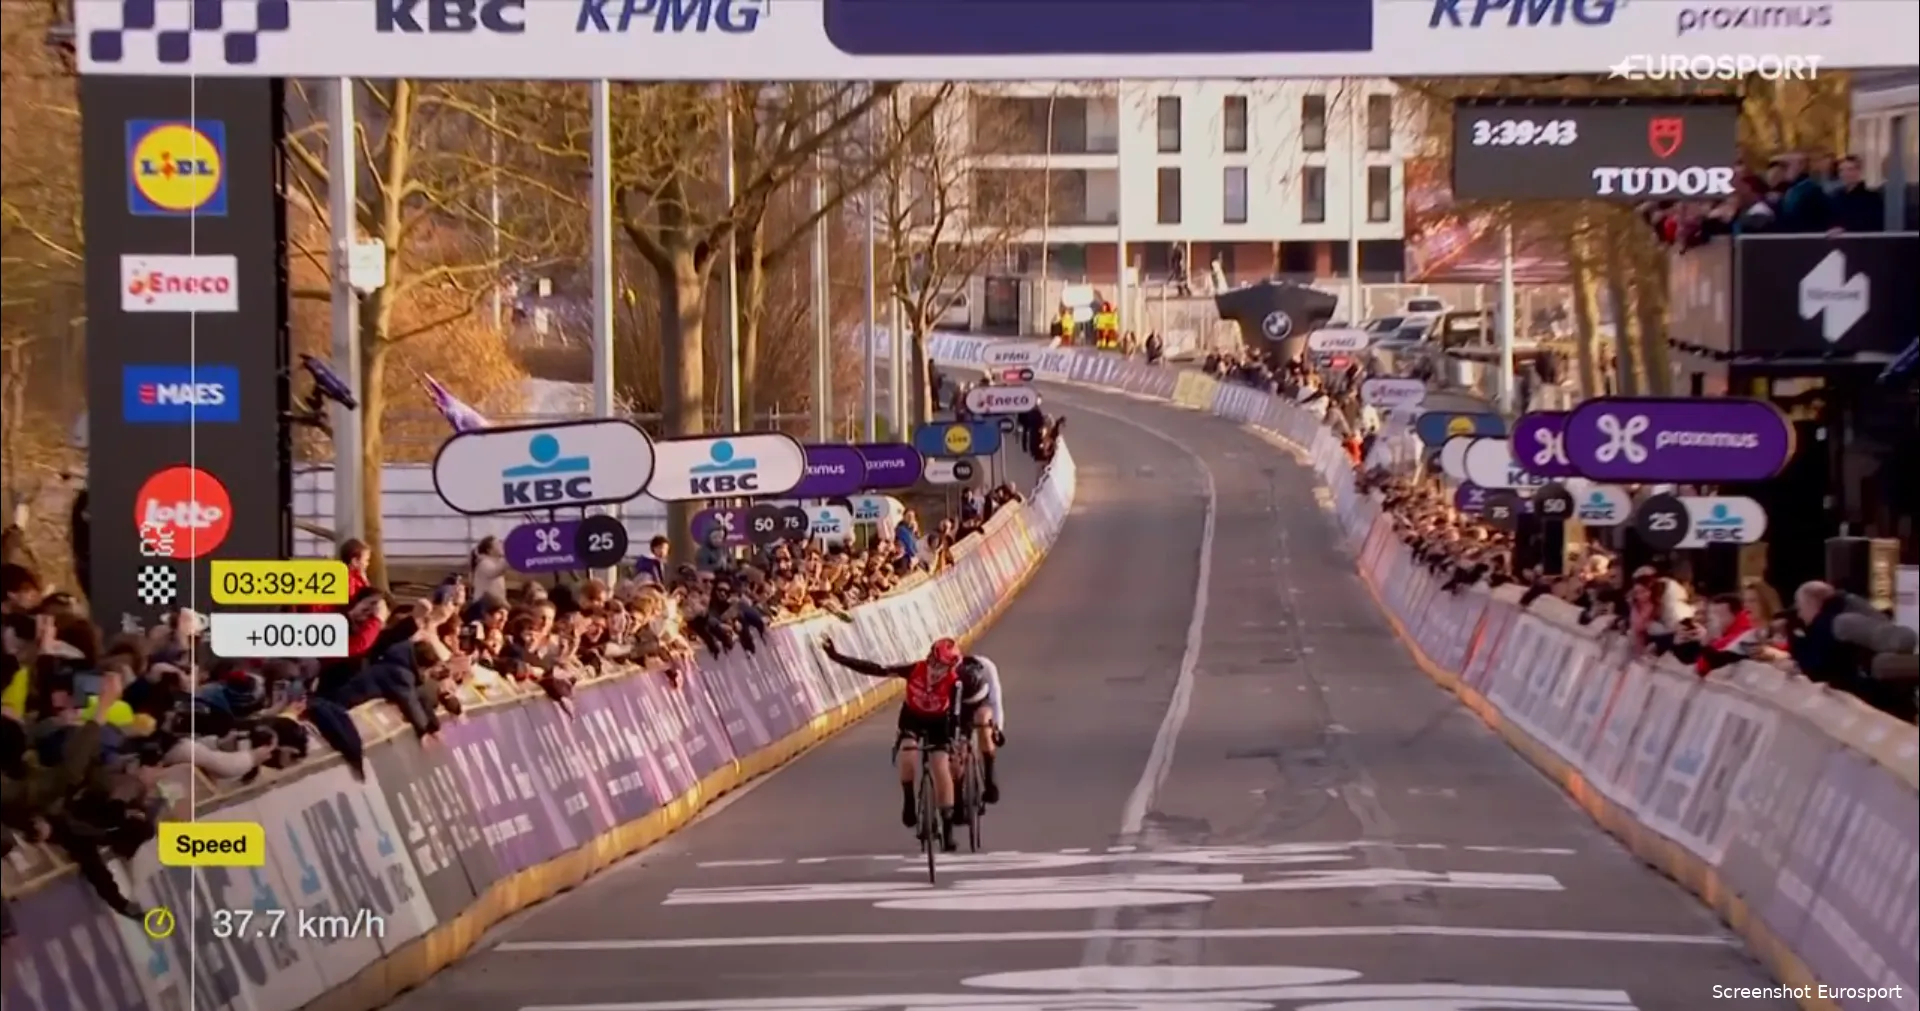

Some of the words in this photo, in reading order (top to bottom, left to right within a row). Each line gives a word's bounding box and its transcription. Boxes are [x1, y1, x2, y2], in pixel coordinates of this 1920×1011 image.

[375, 0, 526, 32] KBC
[576, 0, 760, 32] KPMG
[1429, 0, 1616, 28] KPMG
[1677, 4, 1833, 37] proximus
[1472, 120, 1578, 146] 3:39:43
[1592, 166, 1735, 195] TUDOR
[149, 272, 229, 294] Eneco
[157, 383, 226, 405] MAES
[1655, 430, 1760, 450] proximus
[806, 463, 845, 476] ximus
[864, 458, 905, 471] oximus
[503, 476, 592, 505] KBC
[690, 472, 758, 495] KBC
[146, 498, 223, 529] lotto
[1543, 498, 1566, 513] 50
[754, 517, 774, 532] 50
[783, 517, 799, 529] 75
[1648, 512, 1678, 531] 25
[588, 532, 614, 551] 25
[1695, 528, 1744, 541] KBC
[525, 553, 574, 568] proximus
